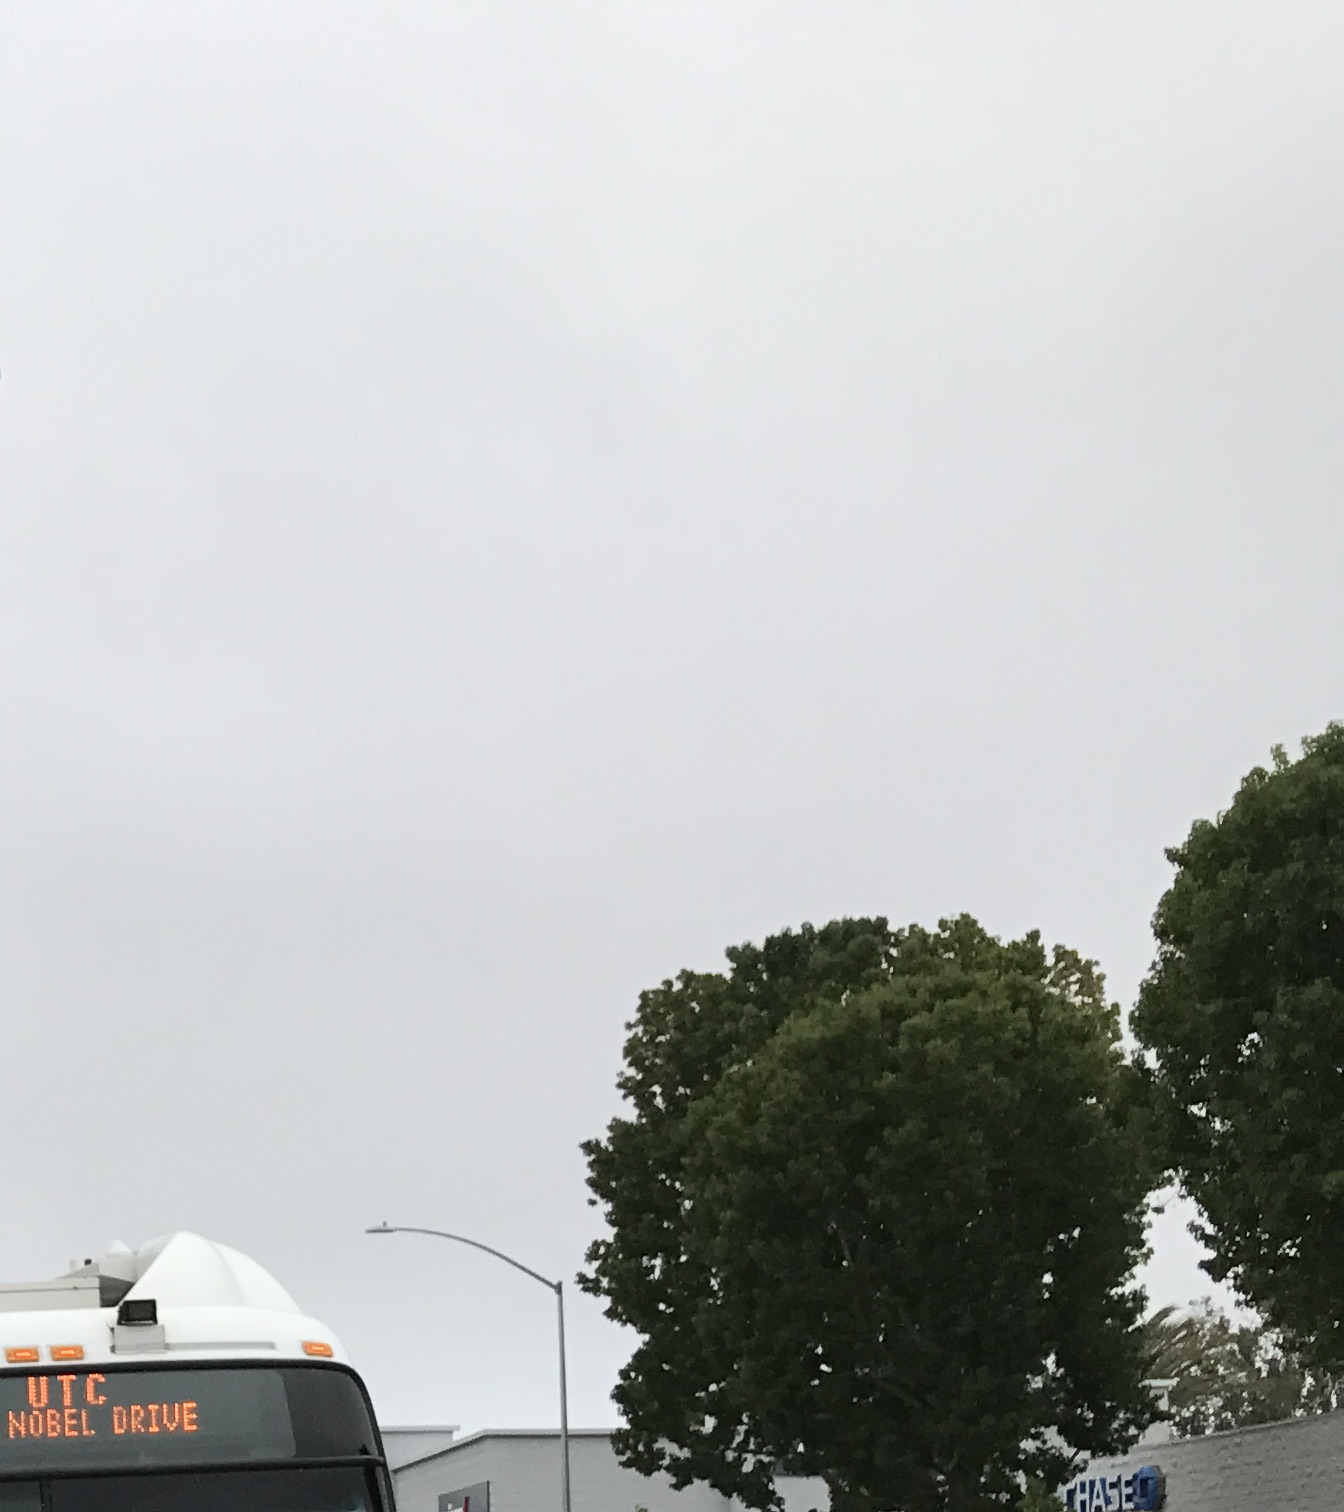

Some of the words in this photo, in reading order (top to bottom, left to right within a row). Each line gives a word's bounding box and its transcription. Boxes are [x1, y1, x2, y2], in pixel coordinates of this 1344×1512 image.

[27, 1373, 108, 1408] UTC
[8, 1407, 96, 1439] NOBEL
[113, 1401, 199, 1435] DRIVE
